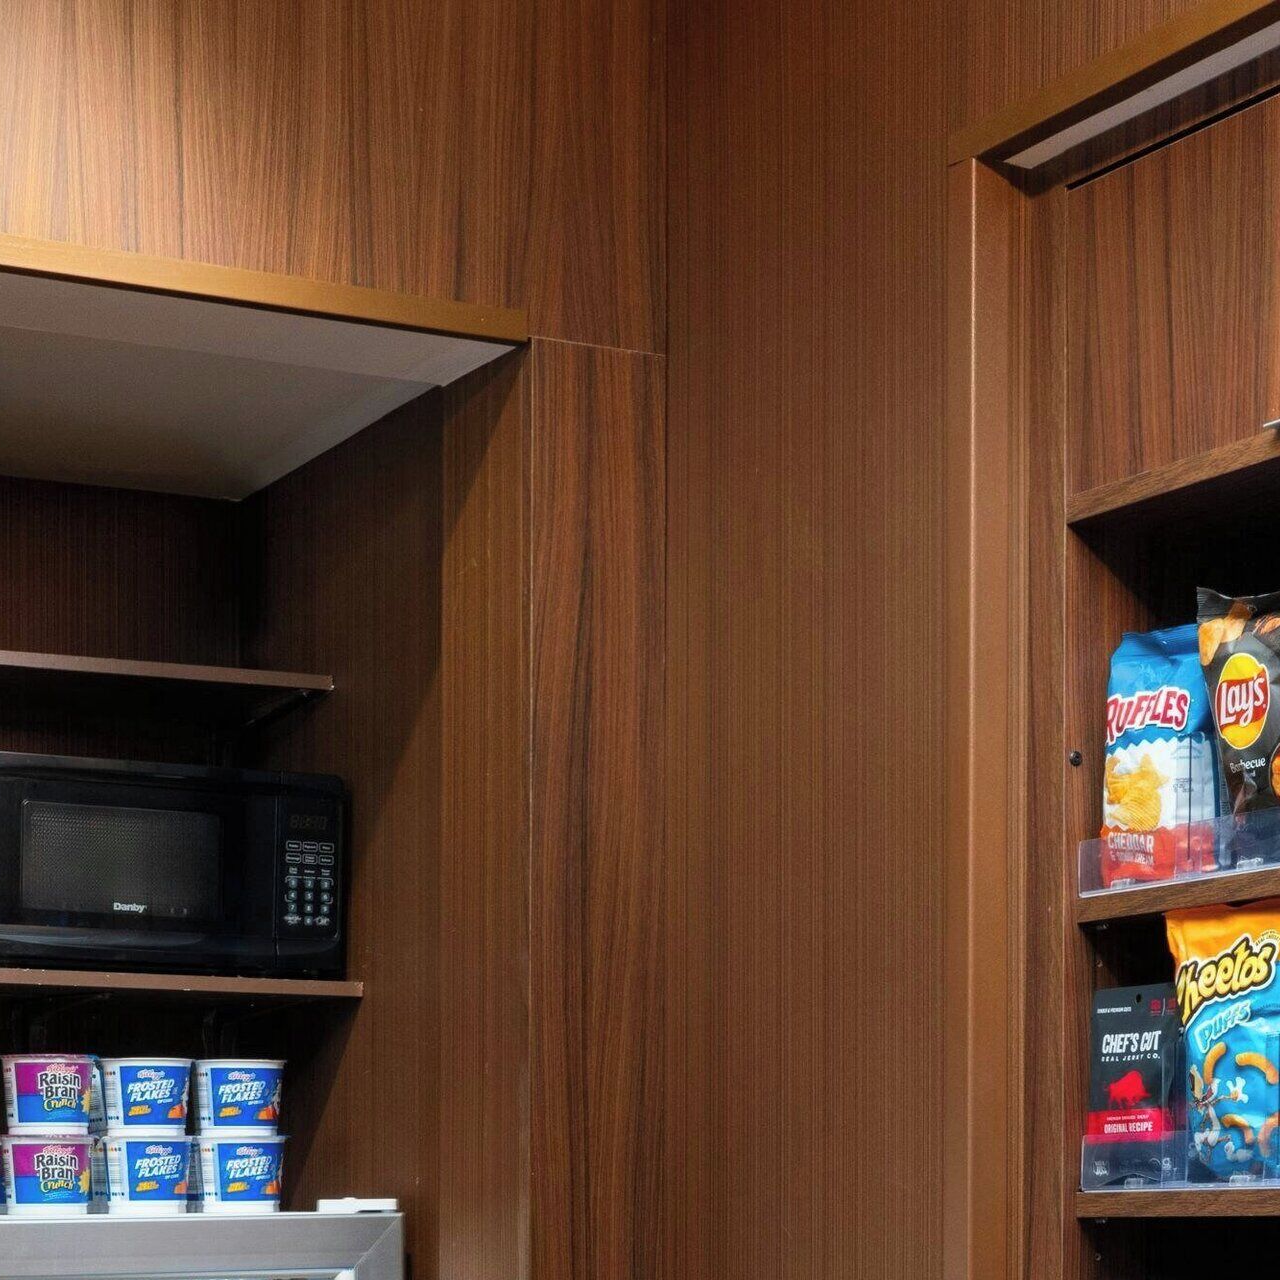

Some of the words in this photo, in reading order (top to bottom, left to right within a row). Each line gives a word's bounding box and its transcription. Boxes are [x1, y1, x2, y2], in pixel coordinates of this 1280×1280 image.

[1220, 676, 1265, 726] Lay's
[1106, 686, 1190, 745] RUFFLES
[1108, 832, 1154, 850] CHEDDAR
[113, 902, 147, 913] Danby
[1140, 1031, 1162, 1050] CUT
[39, 1073, 80, 1088] Raisin
[128, 1080, 174, 1093] FROSTED
[45, 1086, 77, 1098] Bran
[219, 1082, 266, 1095] FROSTED
[130, 1090, 171, 1103] FLAKES
[221, 1091, 262, 1104] FLAKES
[44, 1099, 77, 1111] Crunch
[35, 1153, 78, 1168] Raisin
[135, 1155, 181, 1169] FROSTED
[226, 1157, 272, 1170] FROSTED
[41, 1168, 74, 1180] Bran
[138, 1166, 177, 1178] FLAKES
[229, 1167, 269, 1179] FLAKES
[41, 1180, 74, 1192] Crunch
